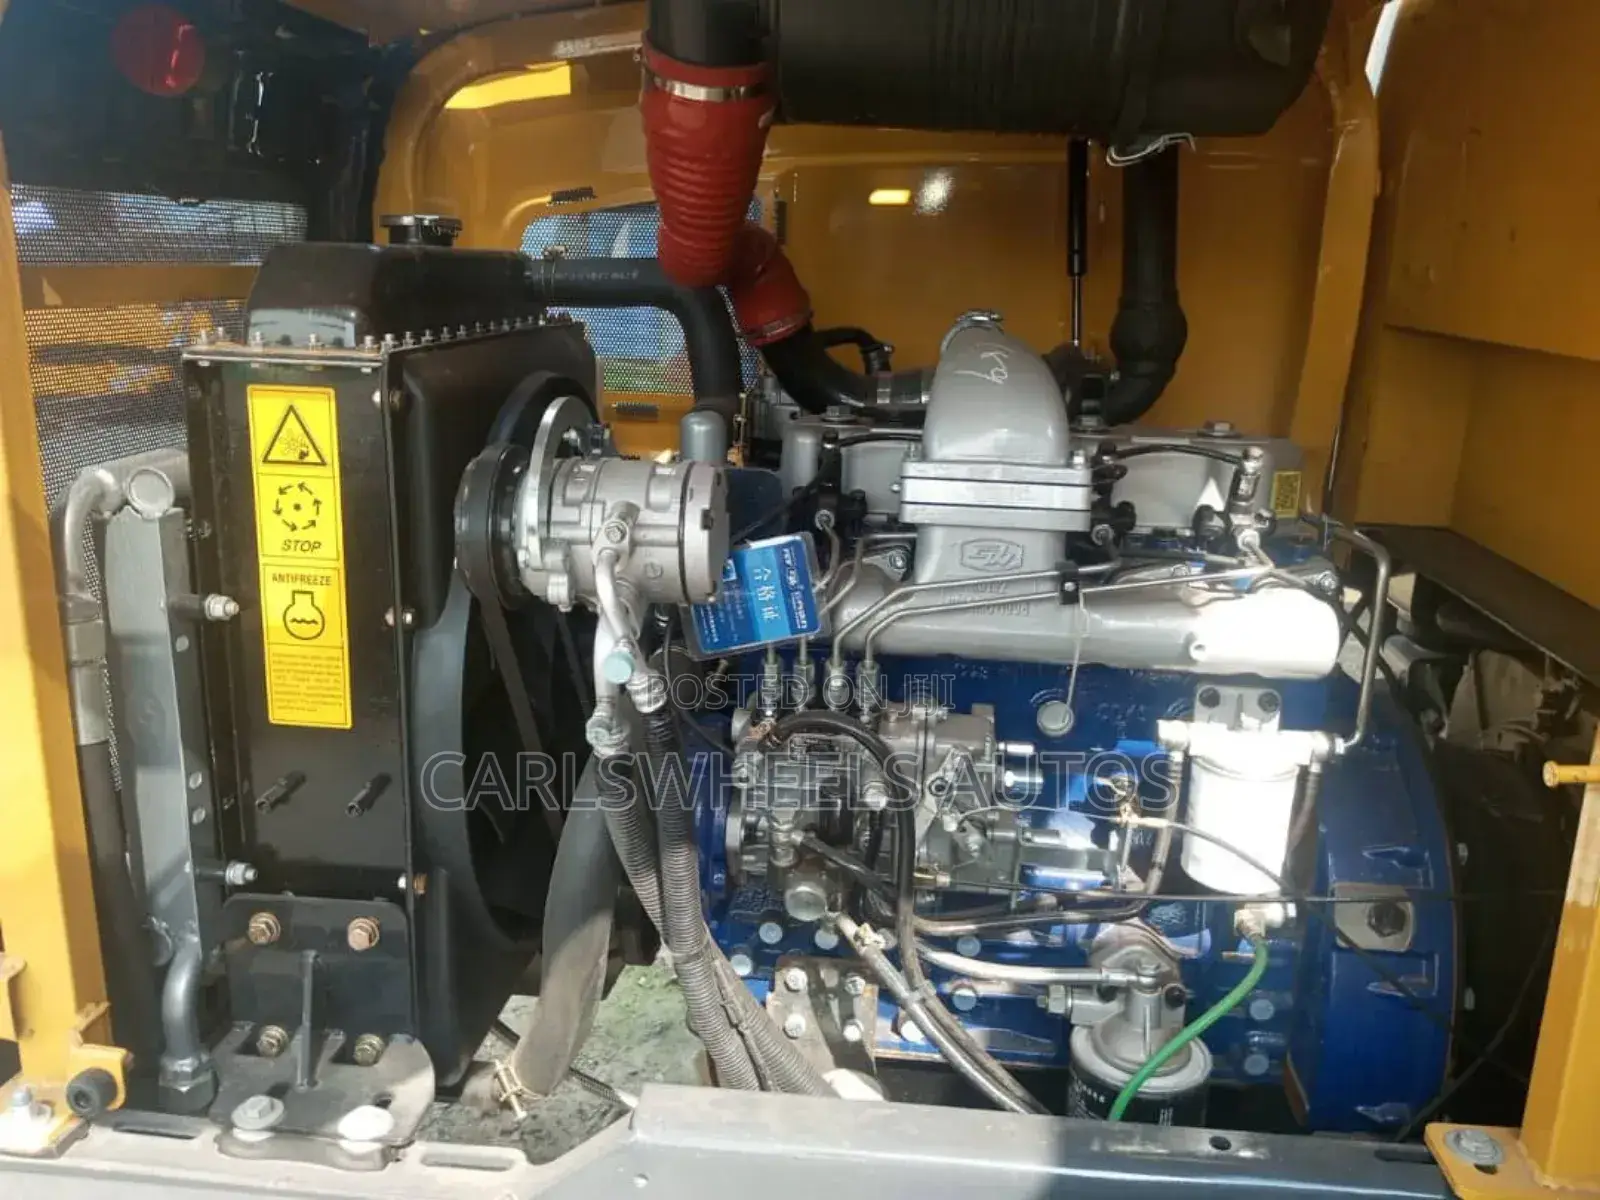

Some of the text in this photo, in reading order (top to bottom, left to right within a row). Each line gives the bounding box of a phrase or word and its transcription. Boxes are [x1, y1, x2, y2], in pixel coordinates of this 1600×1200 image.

[281, 539, 322, 553] STOP
[271, 572, 332, 587] ANTIFREEZE
[753, 567, 780, 622] 合格证
